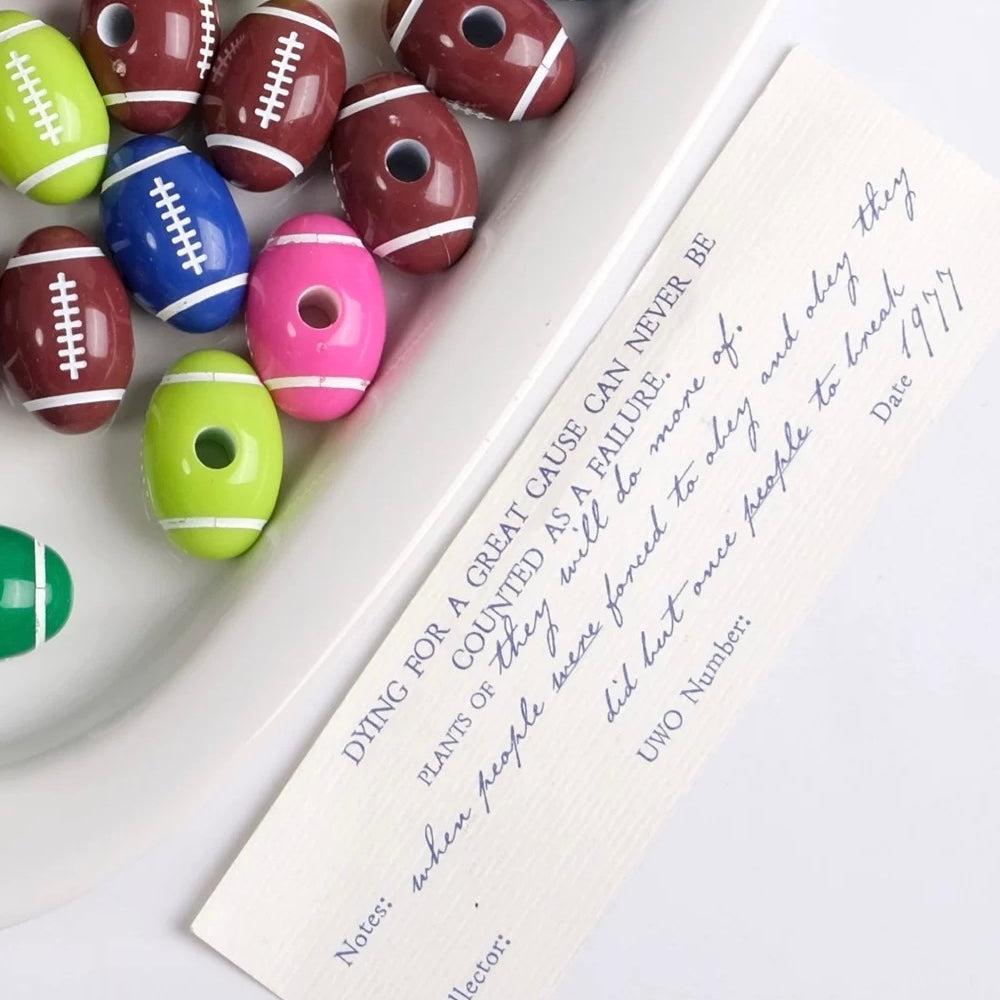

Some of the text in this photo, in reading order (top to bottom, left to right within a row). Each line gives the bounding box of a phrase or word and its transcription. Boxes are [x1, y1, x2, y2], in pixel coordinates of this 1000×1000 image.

[869, 375, 912, 425] Date
[902, 268, 963, 359] 1977
[341, 232, 716, 766] DYING FOR A GREAT CAUSE CAN NEVER BE
[413, 167, 916, 893] when people were forced to obey and obey they
[452, 371, 671, 670] COUNTED AS A FAILURE.
[489, 312, 742, 675] they will do more of.
[605, 269, 905, 723] did but once people to break
[417, 681, 495, 786] PLANTS OF
[636, 615, 751, 762] UWO Number:
[334, 897, 392, 967] Notes:
